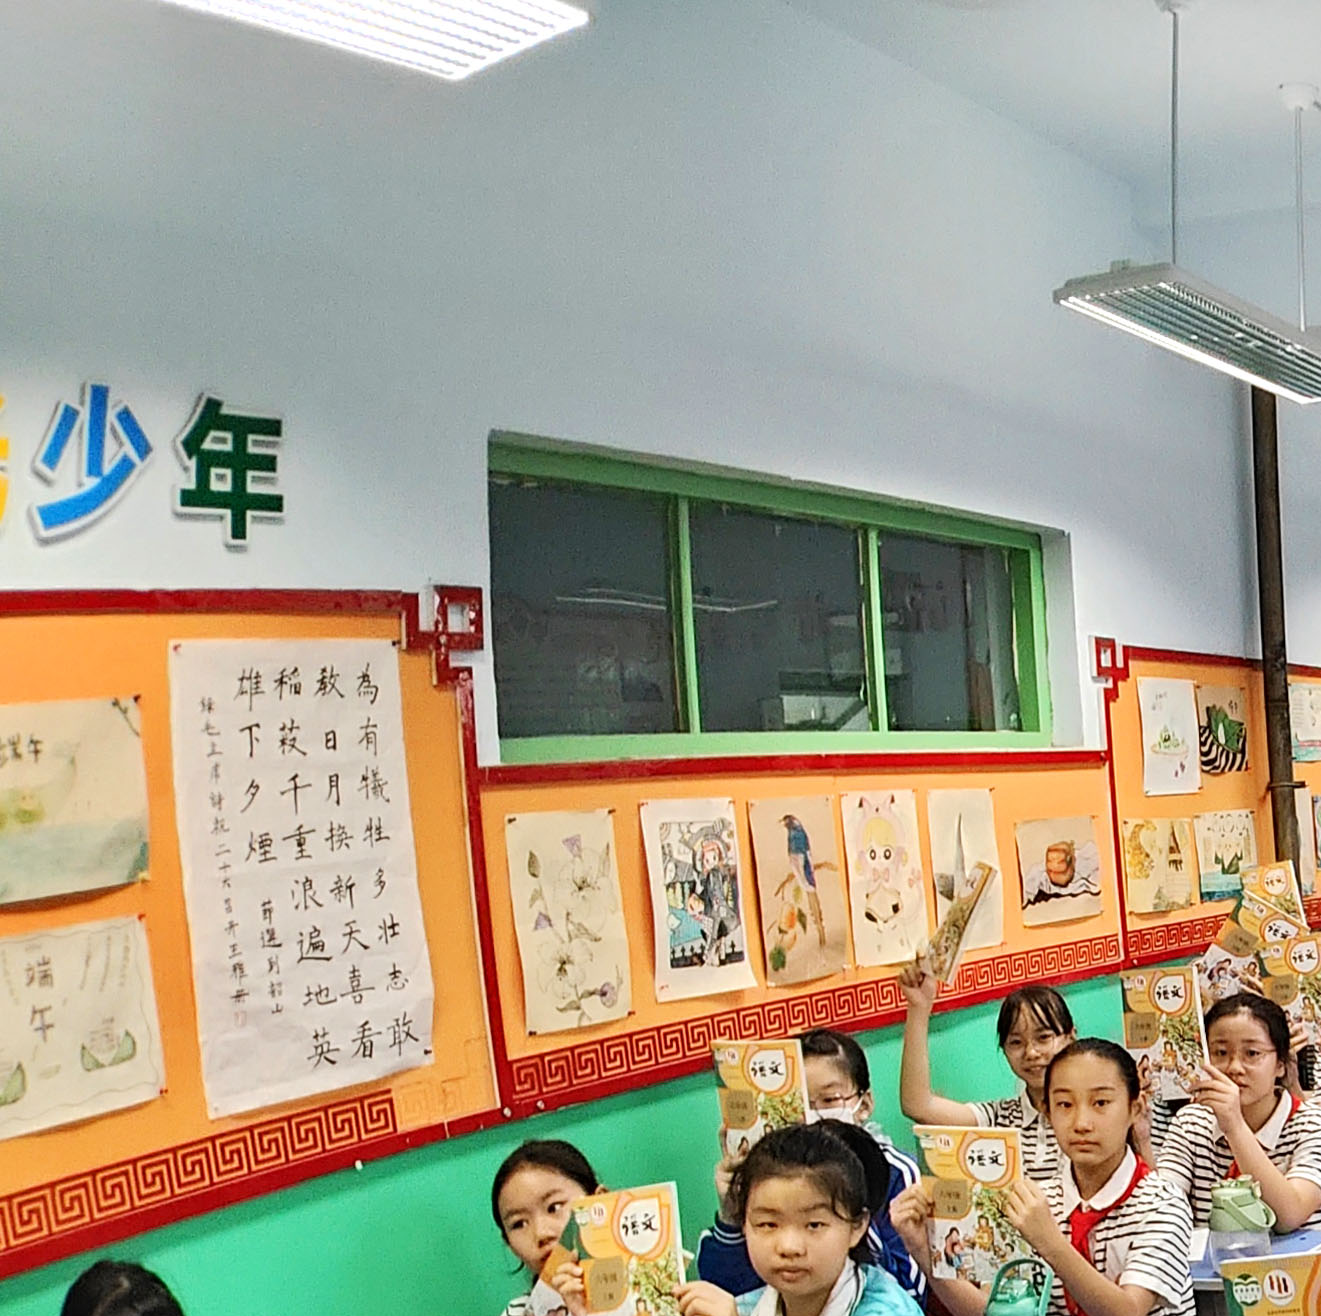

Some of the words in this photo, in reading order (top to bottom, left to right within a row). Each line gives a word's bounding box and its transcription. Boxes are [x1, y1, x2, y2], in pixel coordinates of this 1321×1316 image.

[1292, 951, 1317, 963] 语文
[25, 956, 56, 1044] 端午
[1156, 984, 1185, 1001] 语文
[750, 1060, 785, 1078] 语文
[968, 1147, 1006, 1168] 语文
[621, 1213, 660, 1237] 语文
